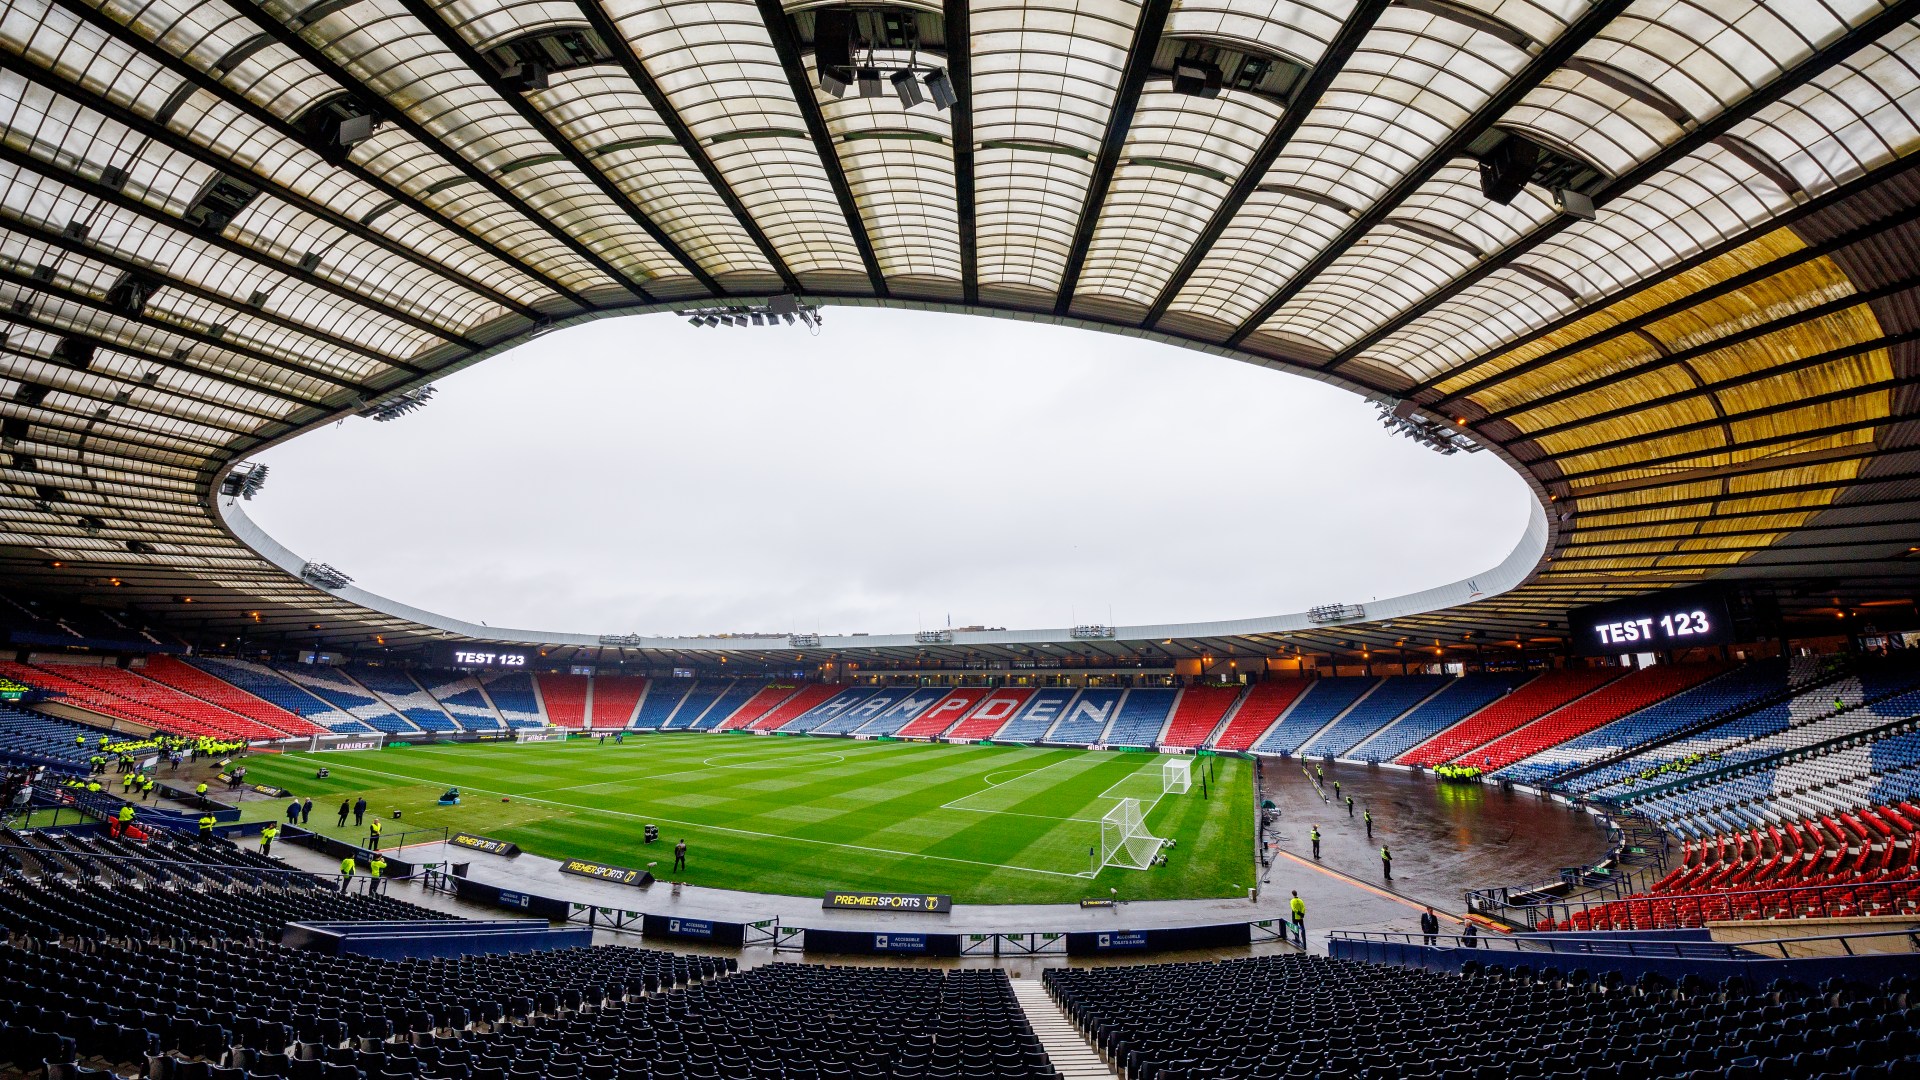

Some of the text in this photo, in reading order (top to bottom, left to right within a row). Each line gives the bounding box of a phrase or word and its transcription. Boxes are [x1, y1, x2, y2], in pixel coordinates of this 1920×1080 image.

[1595, 611, 1709, 644] TEST 123
[455, 652, 525, 666] TEST 123
[813, 697, 1113, 722] HAMPDEN
[1159, 747, 1187, 755] UNIBET
